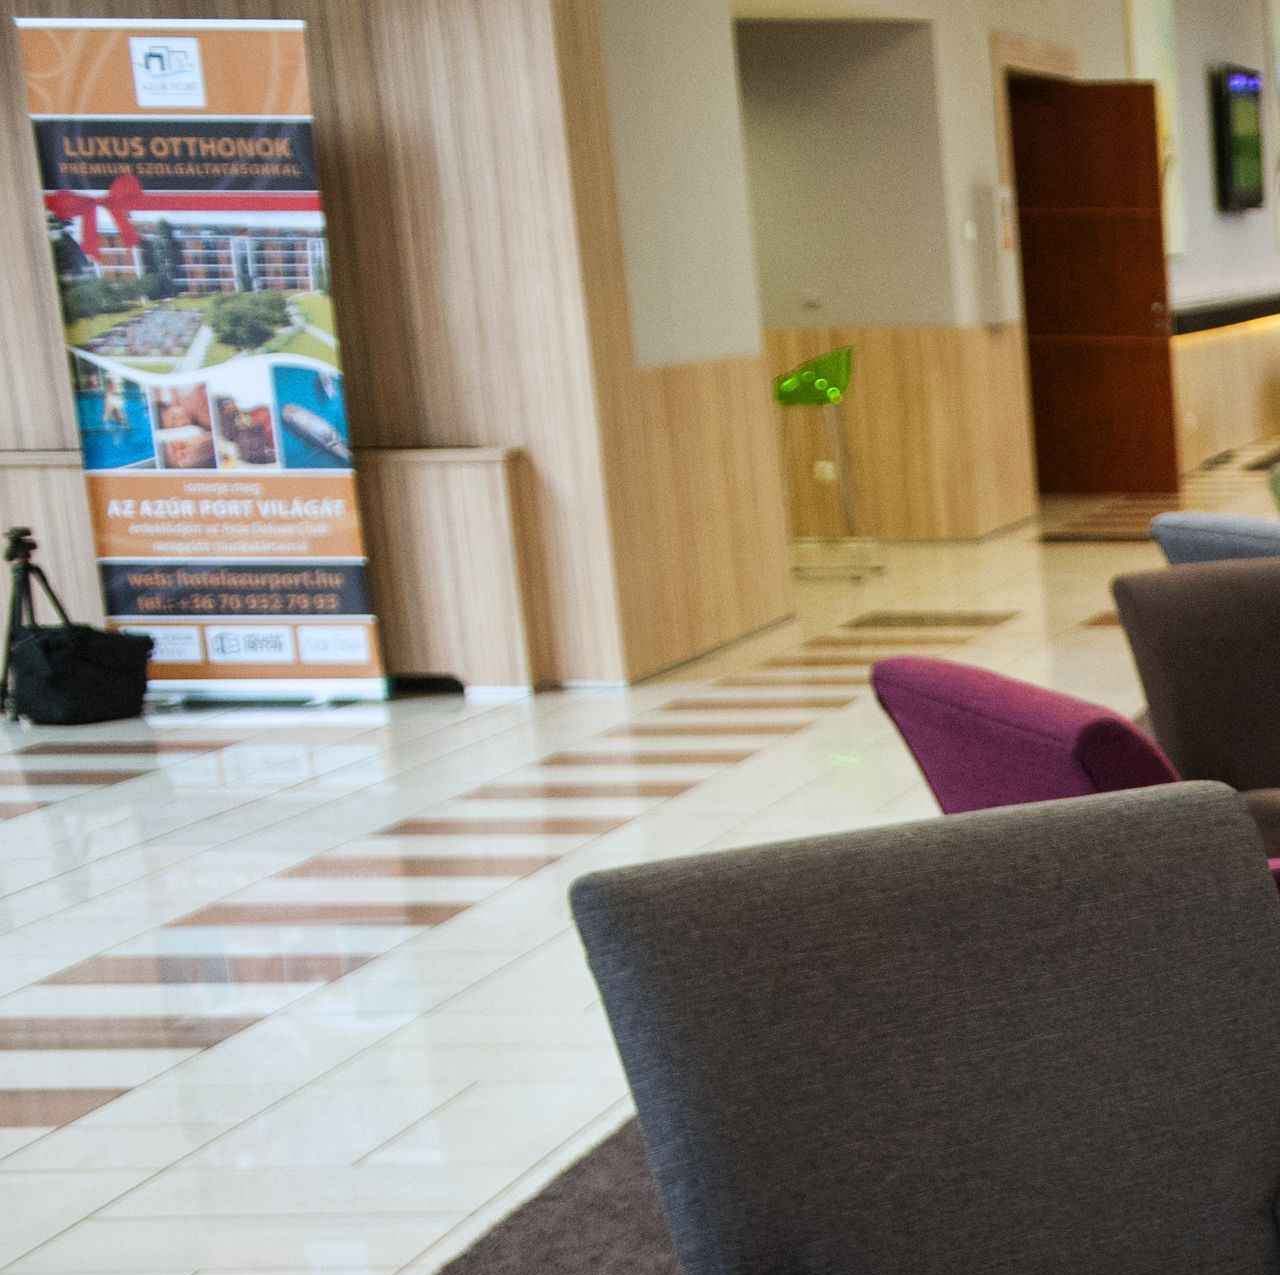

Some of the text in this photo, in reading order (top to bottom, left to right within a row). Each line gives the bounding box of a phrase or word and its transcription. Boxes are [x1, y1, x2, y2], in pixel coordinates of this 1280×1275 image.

[63, 135, 294, 159] LUXUS OTTHONOK
[107, 495, 347, 518] AZ AZÚR PORT VILÁGÁT
